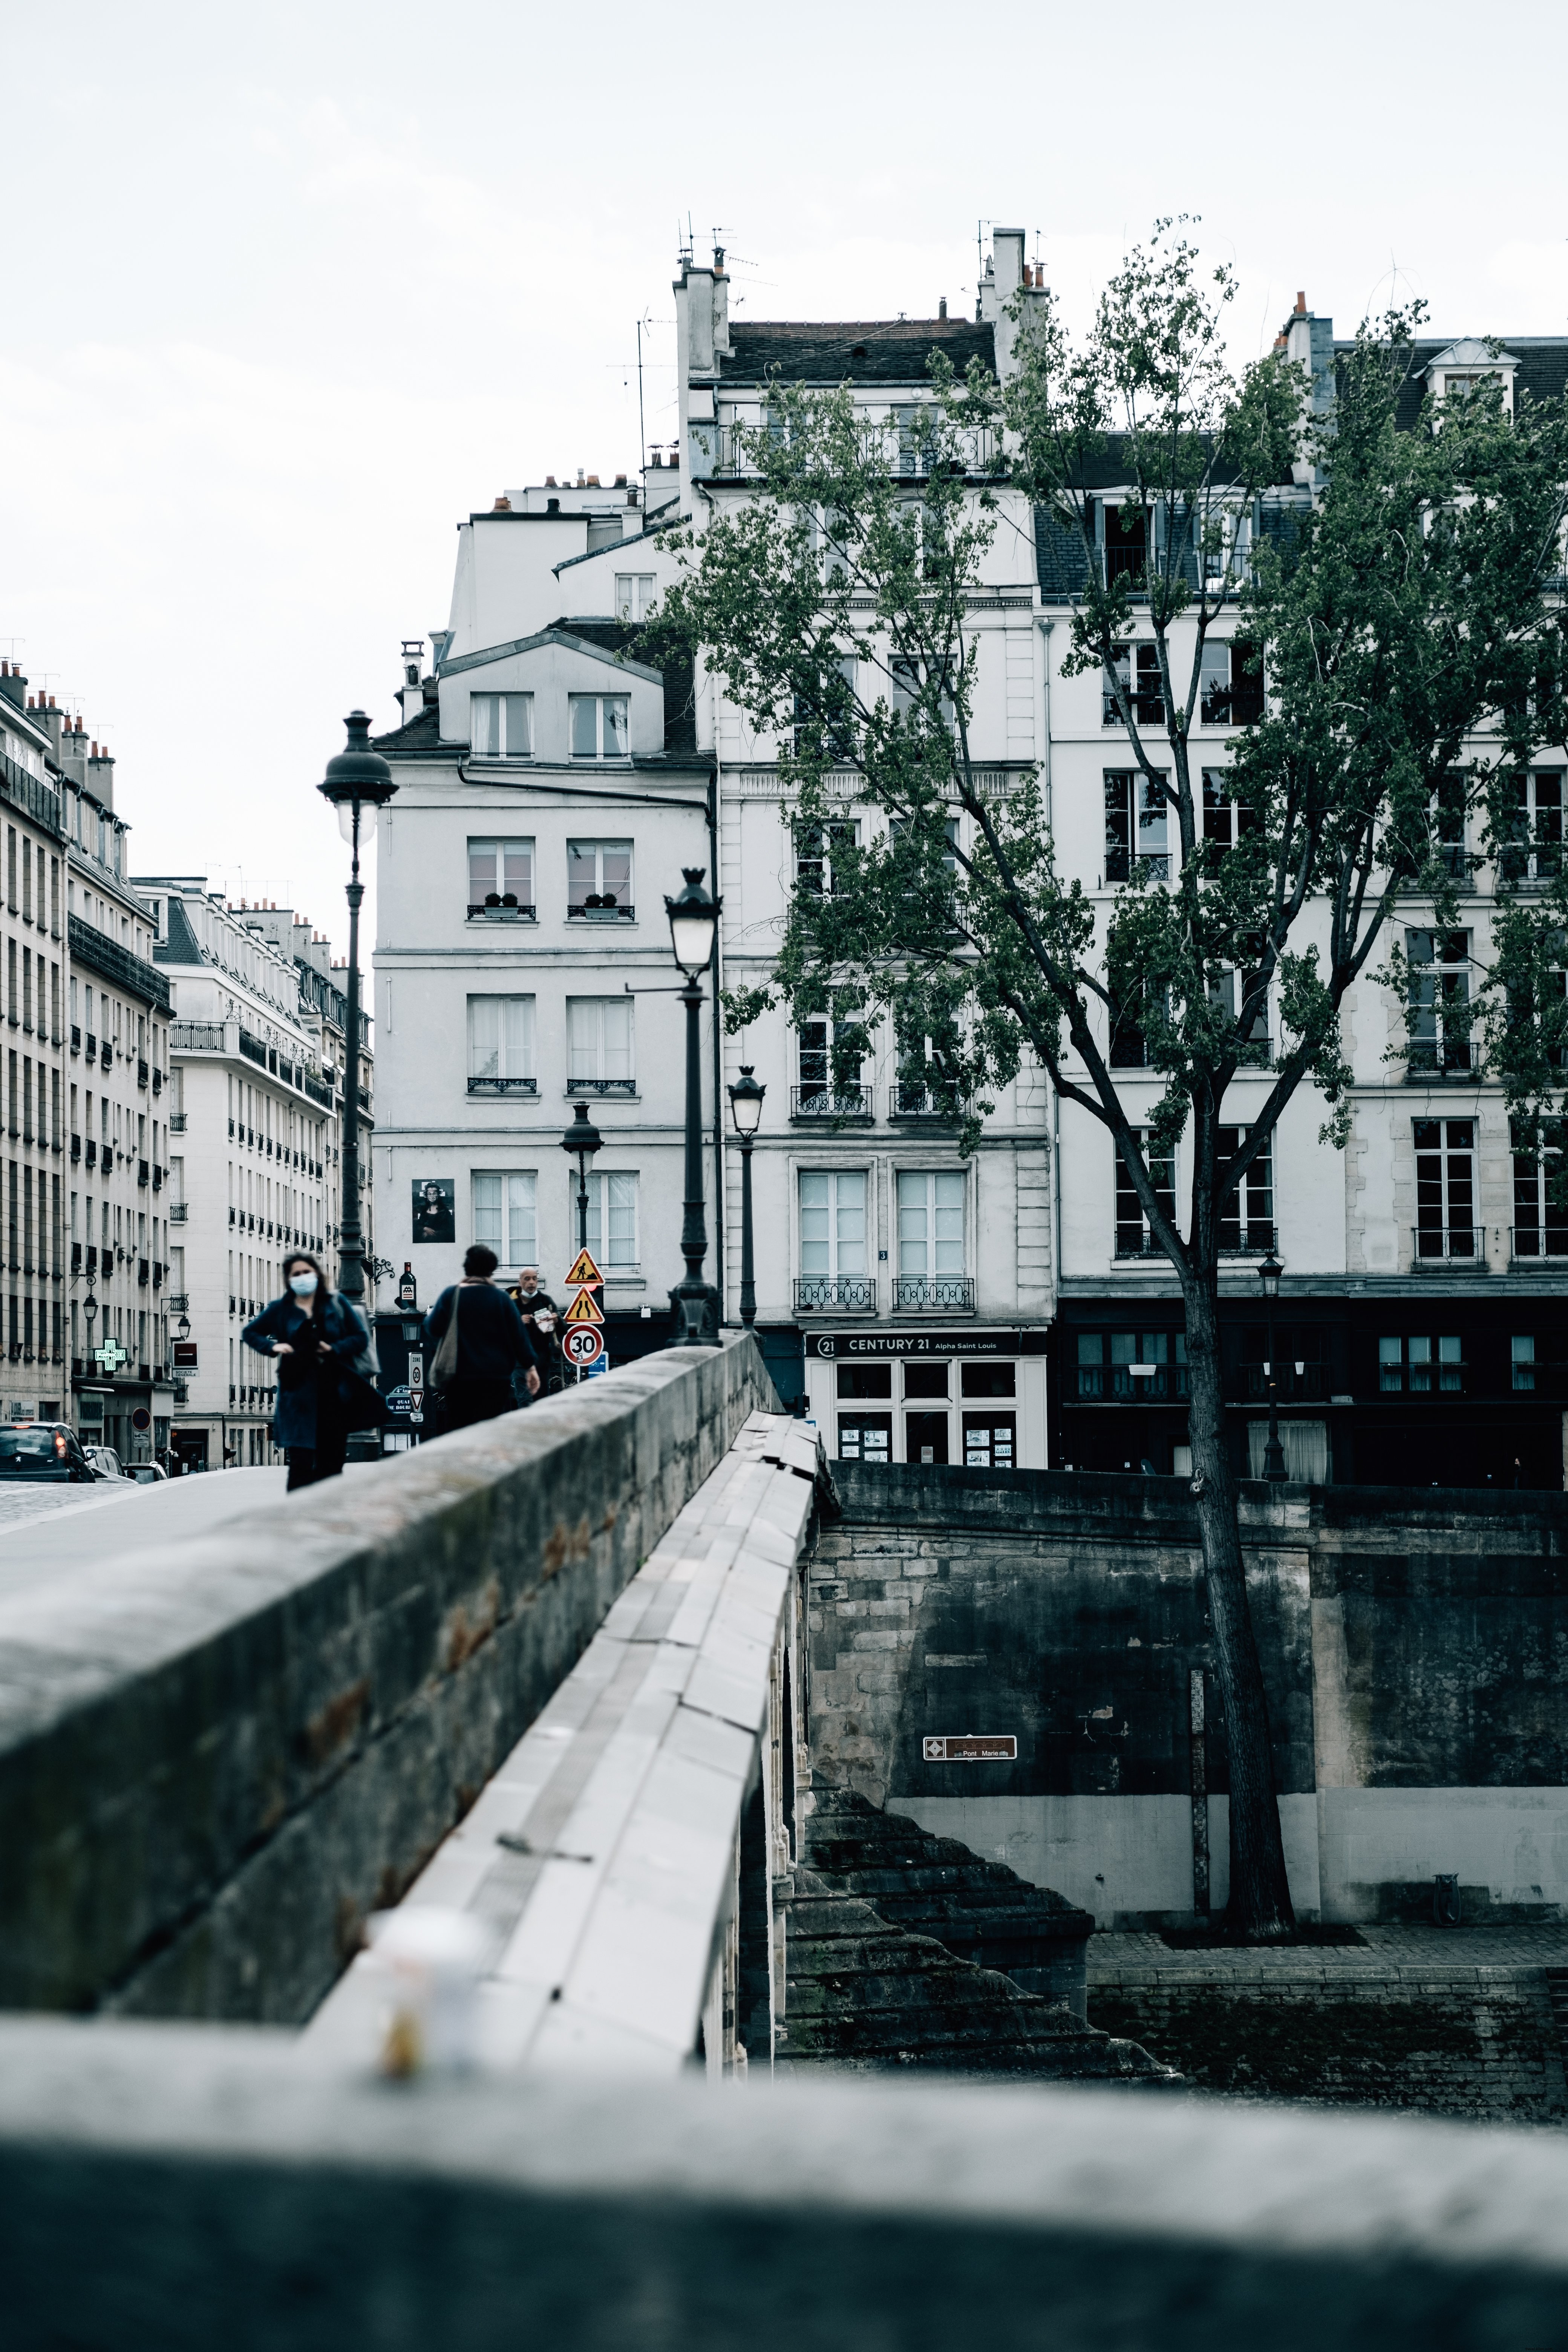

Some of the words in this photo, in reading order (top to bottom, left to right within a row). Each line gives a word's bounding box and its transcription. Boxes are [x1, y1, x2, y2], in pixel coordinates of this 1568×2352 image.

[572, 1335, 595, 1354] 30
[823, 1341, 834, 1352] 21
[849, 1339, 914, 1350] CENTURY
[918, 1339, 929, 1349] 21
